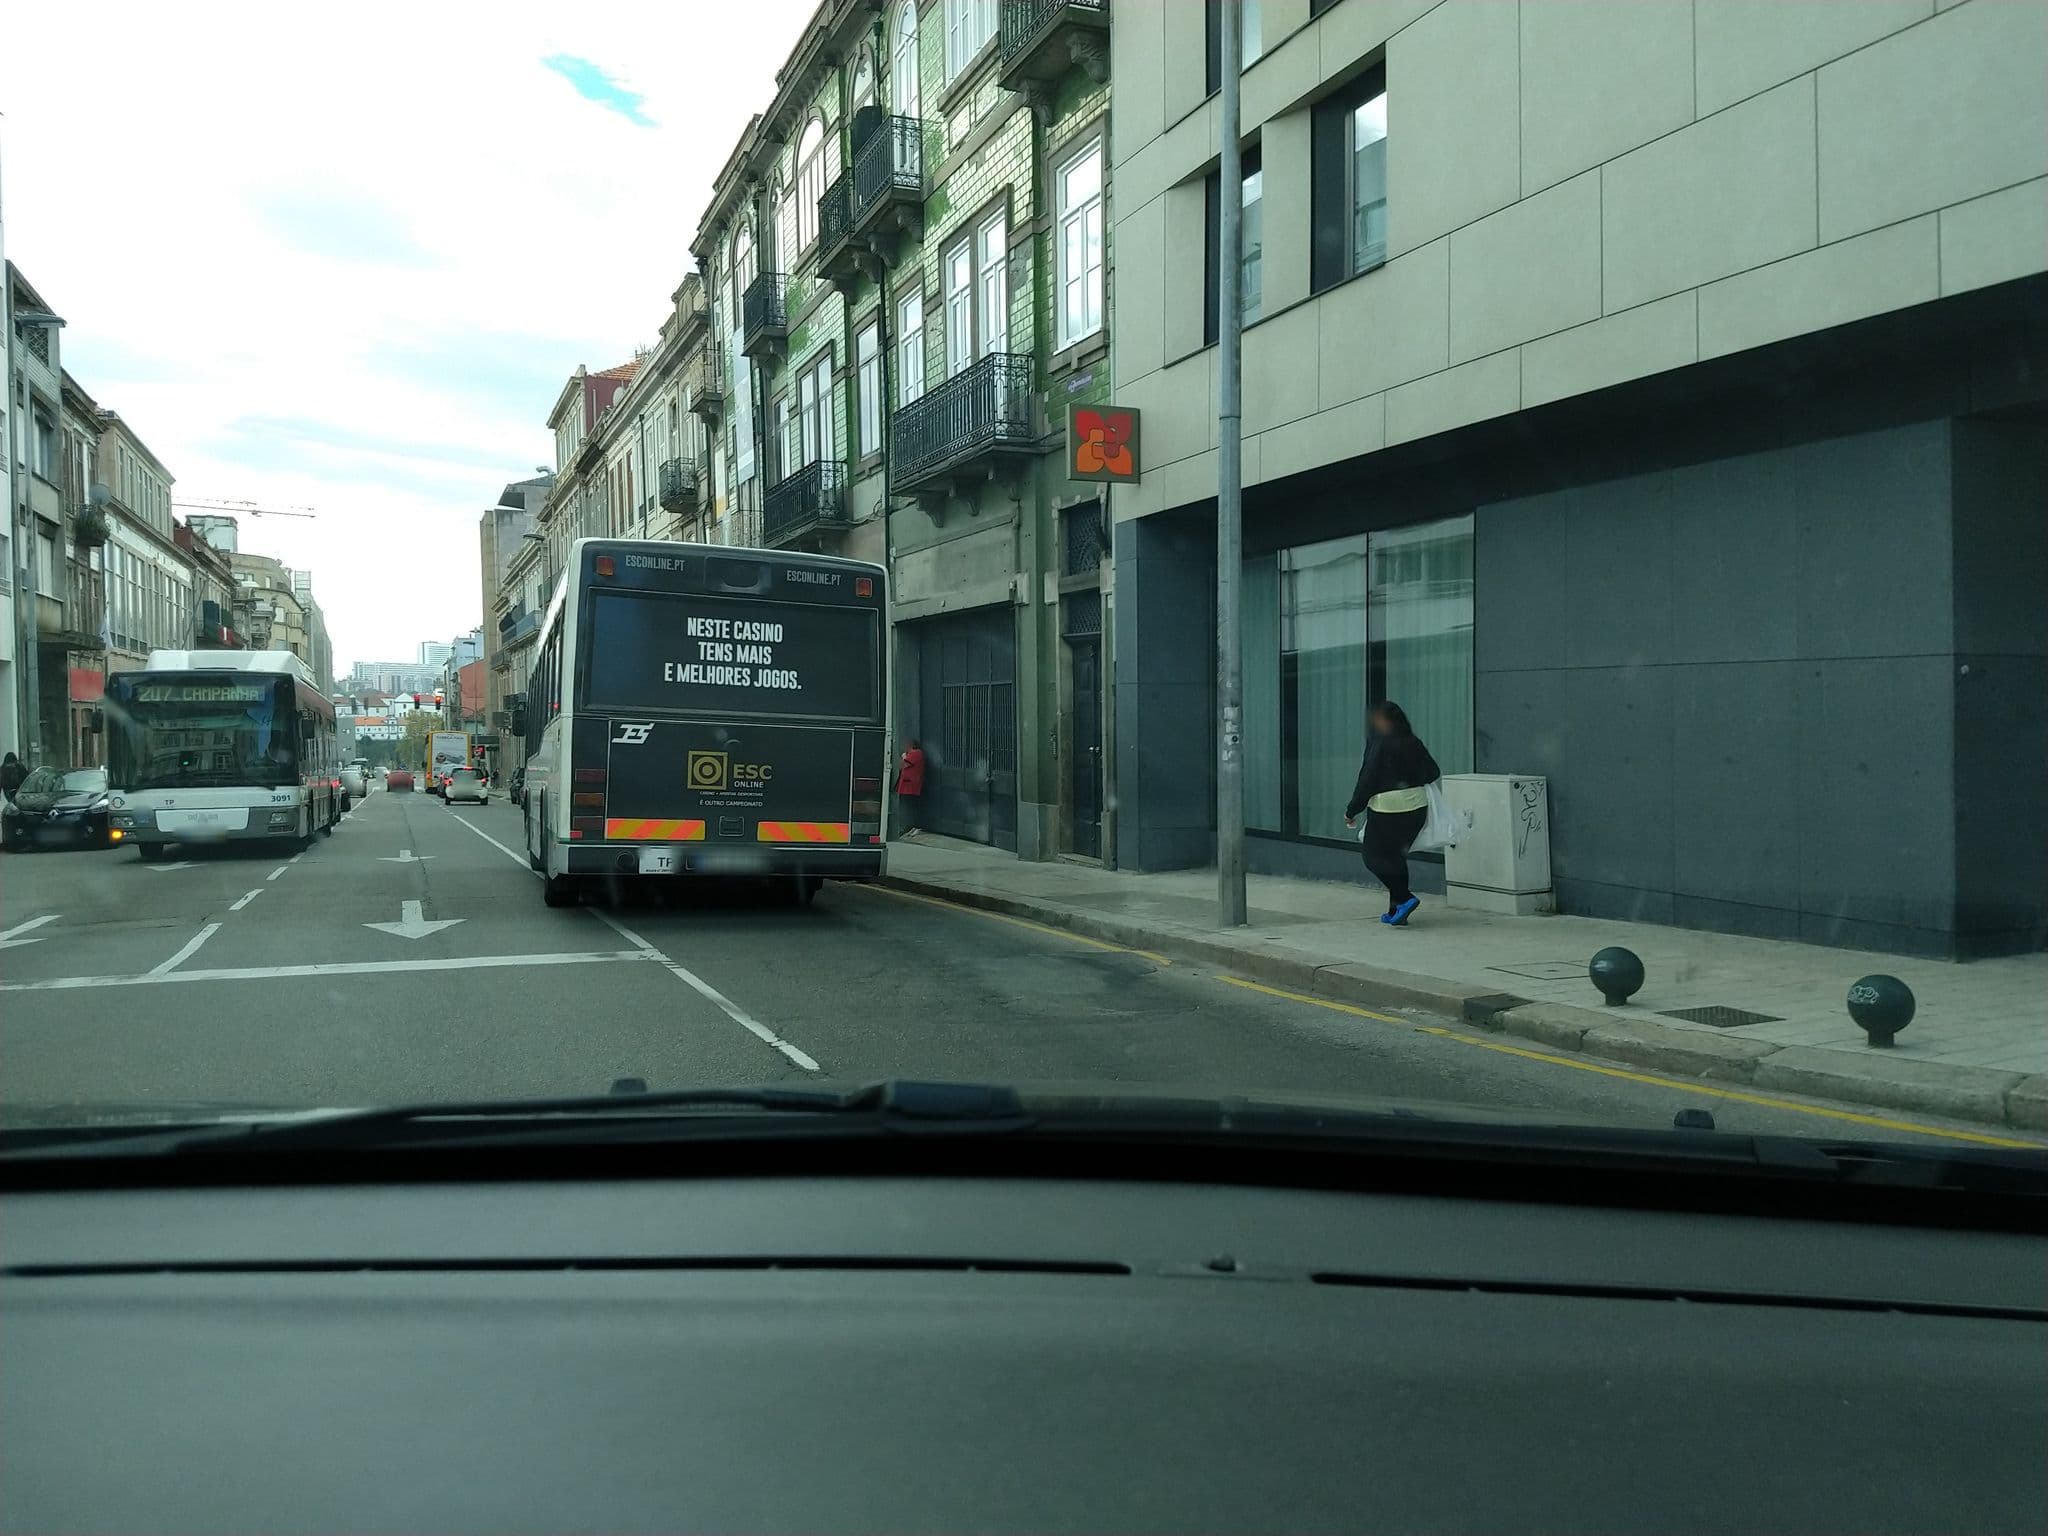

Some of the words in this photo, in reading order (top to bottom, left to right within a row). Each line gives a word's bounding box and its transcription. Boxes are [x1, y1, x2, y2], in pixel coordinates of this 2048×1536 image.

[625, 554, 685, 572] ESCONLINE.PT
[786, 569, 842, 586] ESCONLINE.PT
[687, 617, 731, 639] NESTE
[733, 620, 784, 643] CASINO
[698, 641, 733, 662] TENS
[736, 644, 773, 665] MAIS
[664, 662, 674, 682] E
[676, 663, 751, 687] MELHORES
[753, 668, 802, 690] JOGOS.
[733, 763, 773, 780] ESC
[733, 780, 765, 788] ONLINE
[271, 794, 291, 803] 3091
